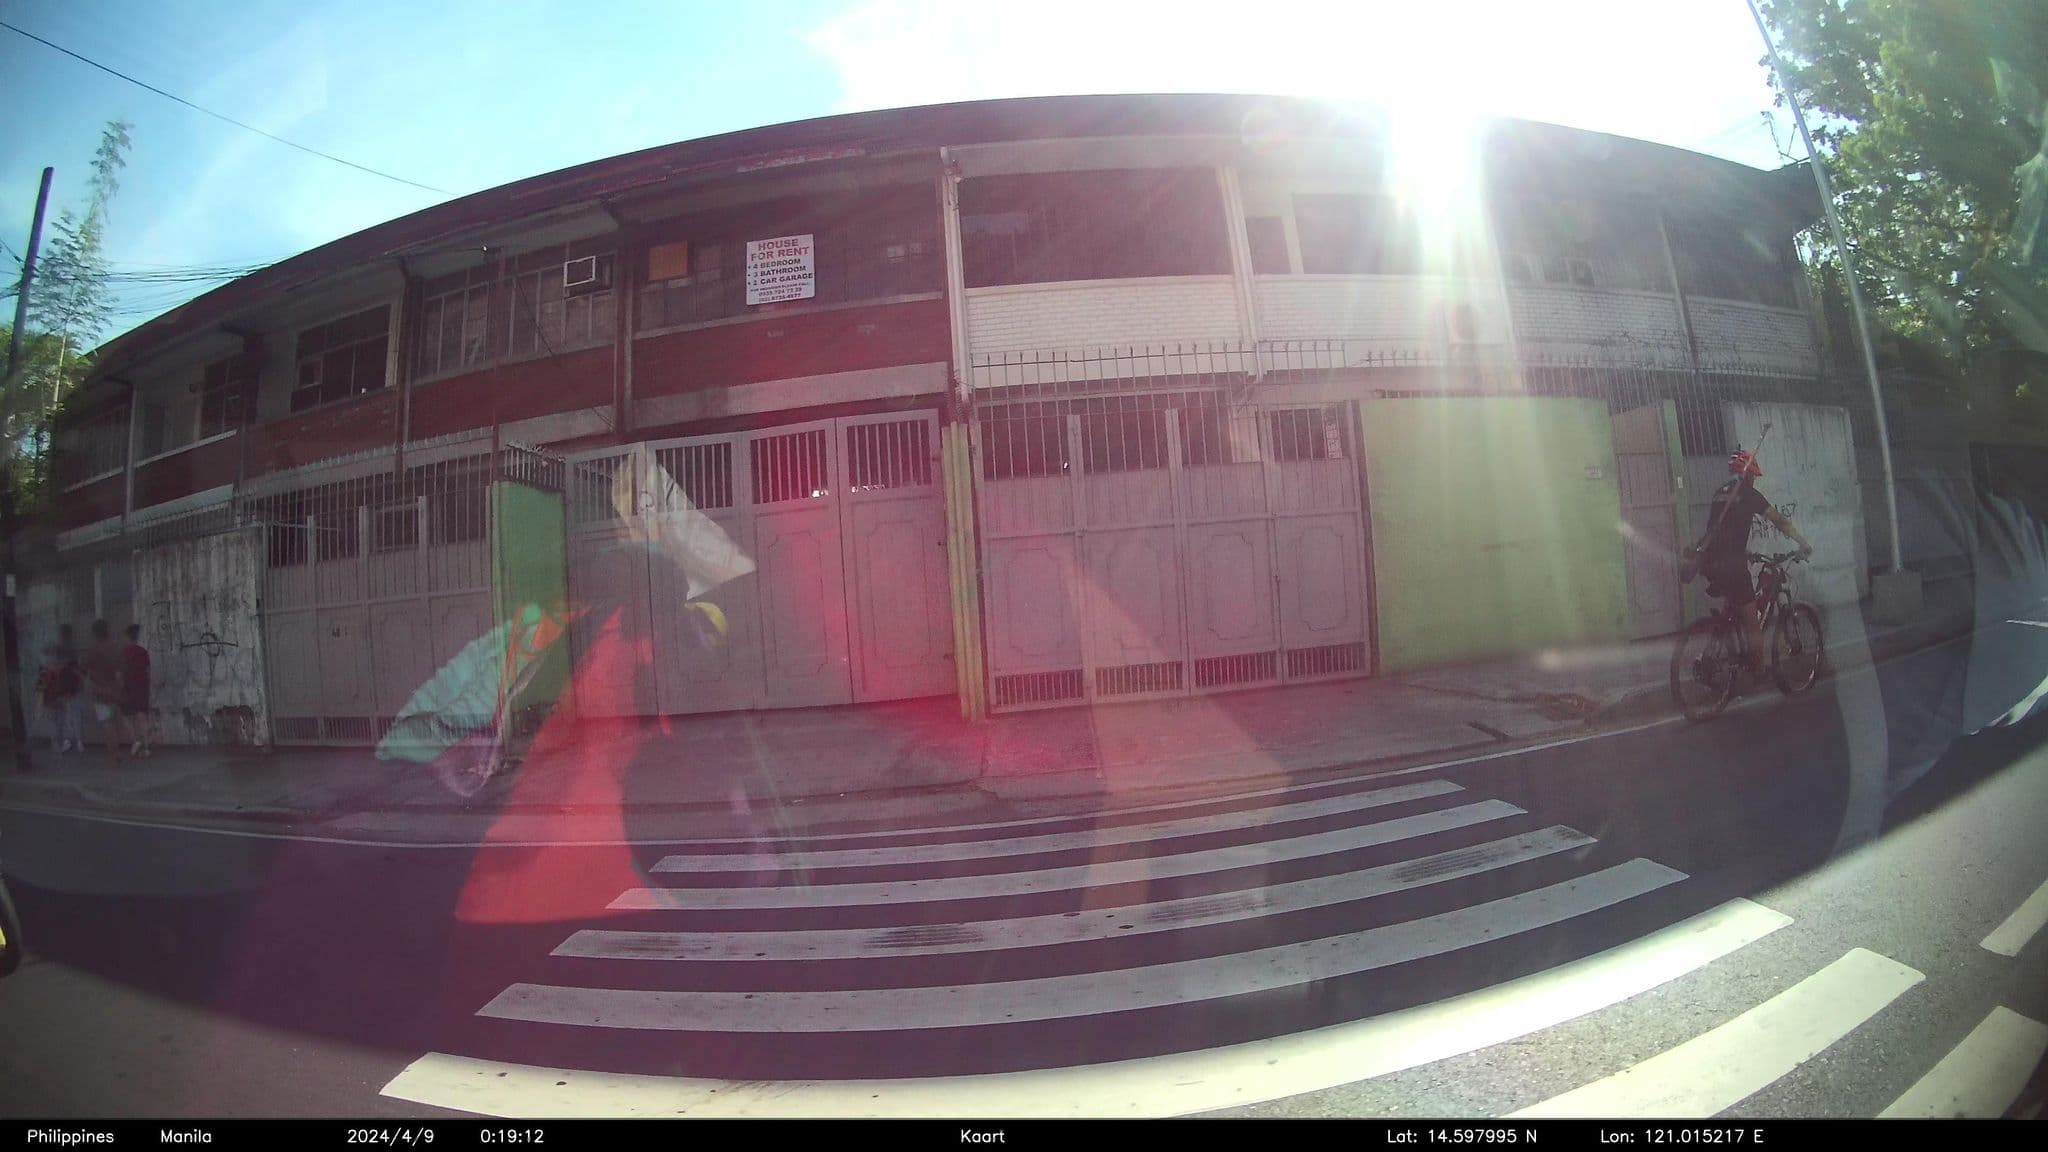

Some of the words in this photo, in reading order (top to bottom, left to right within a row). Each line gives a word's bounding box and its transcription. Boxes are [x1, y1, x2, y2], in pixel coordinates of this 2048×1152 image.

[758, 239, 799, 251] HOUSE
[751, 251, 774, 261] FOR
[778, 246, 809, 257] RENT
[760, 258, 801, 269] BEDROOM
[760, 265, 807, 277] BATHROOM
[760, 277, 777, 285] CAR
[779, 272, 814, 282] GARAGE
